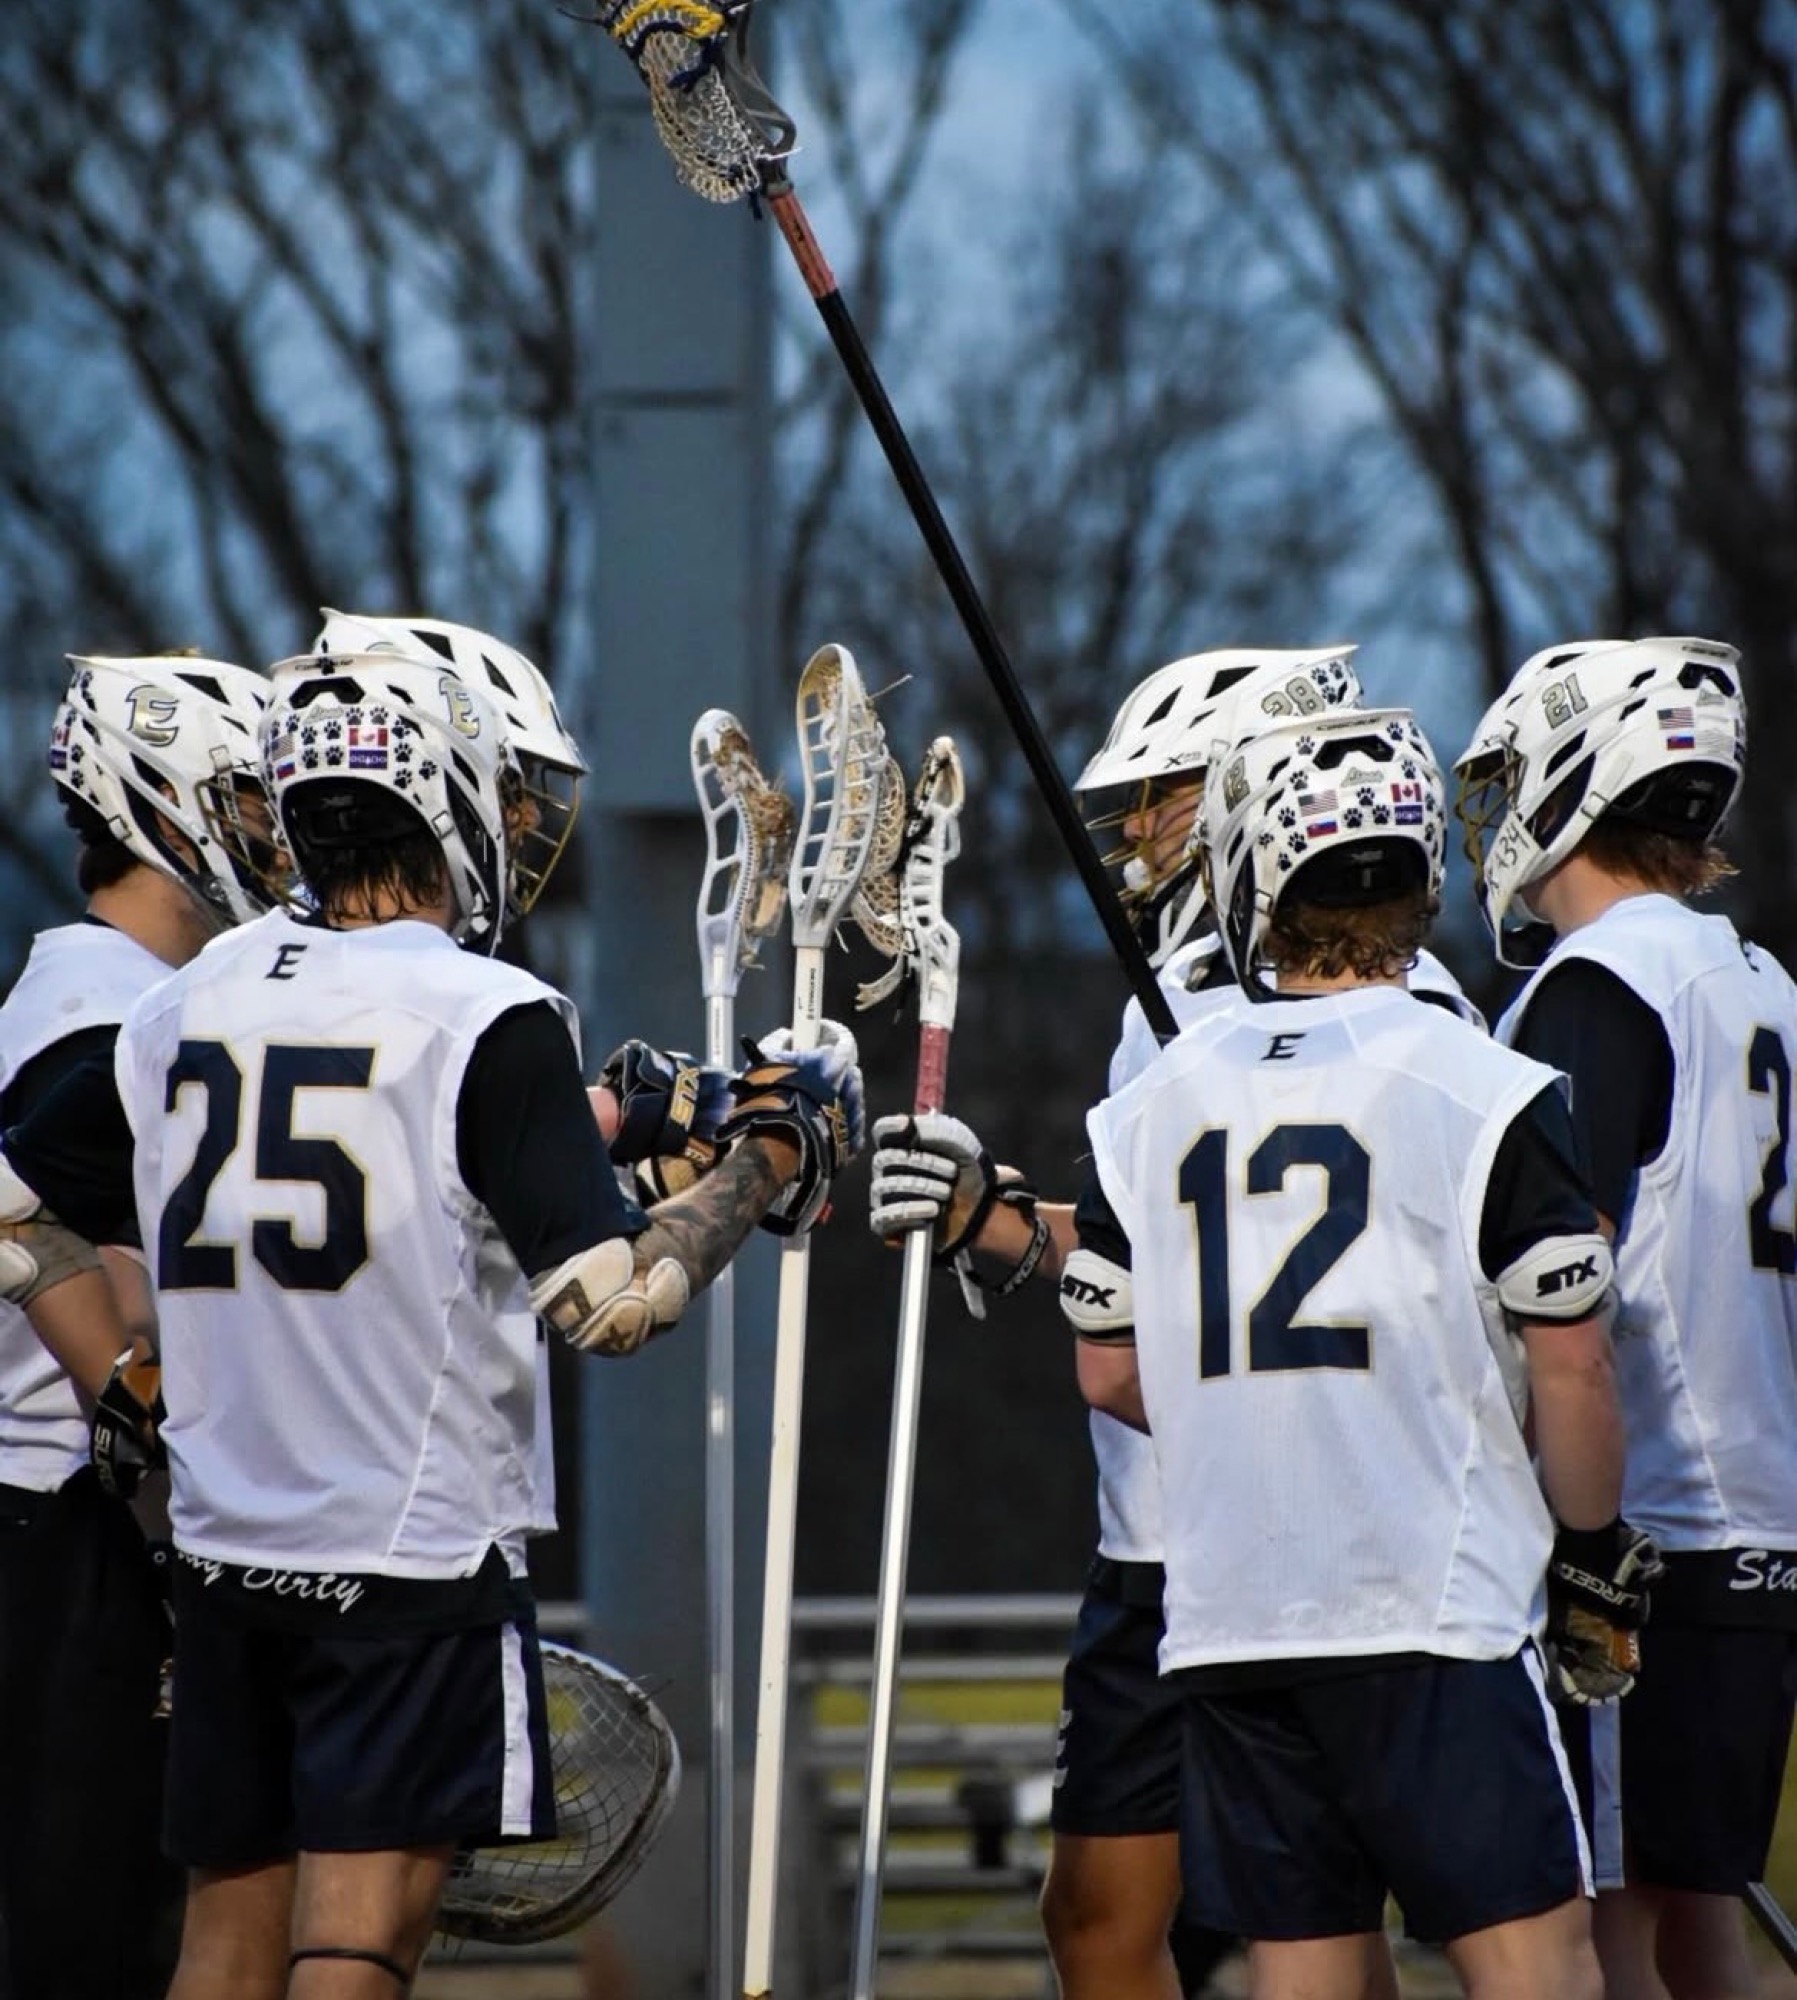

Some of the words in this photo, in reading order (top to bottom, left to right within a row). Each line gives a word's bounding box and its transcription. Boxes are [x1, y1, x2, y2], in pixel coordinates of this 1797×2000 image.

[125, 684, 180, 747] E
[439, 676, 480, 739] E
[1541, 672, 1588, 730] 21
[264, 943, 308, 980] E
[1260, 1033, 1307, 1061] E
[158, 1035, 382, 1293] 25
[1177, 1121, 1373, 1383] 12
[1535, 1254, 1598, 1297] STX
[1061, 1274, 1117, 1310] STX
